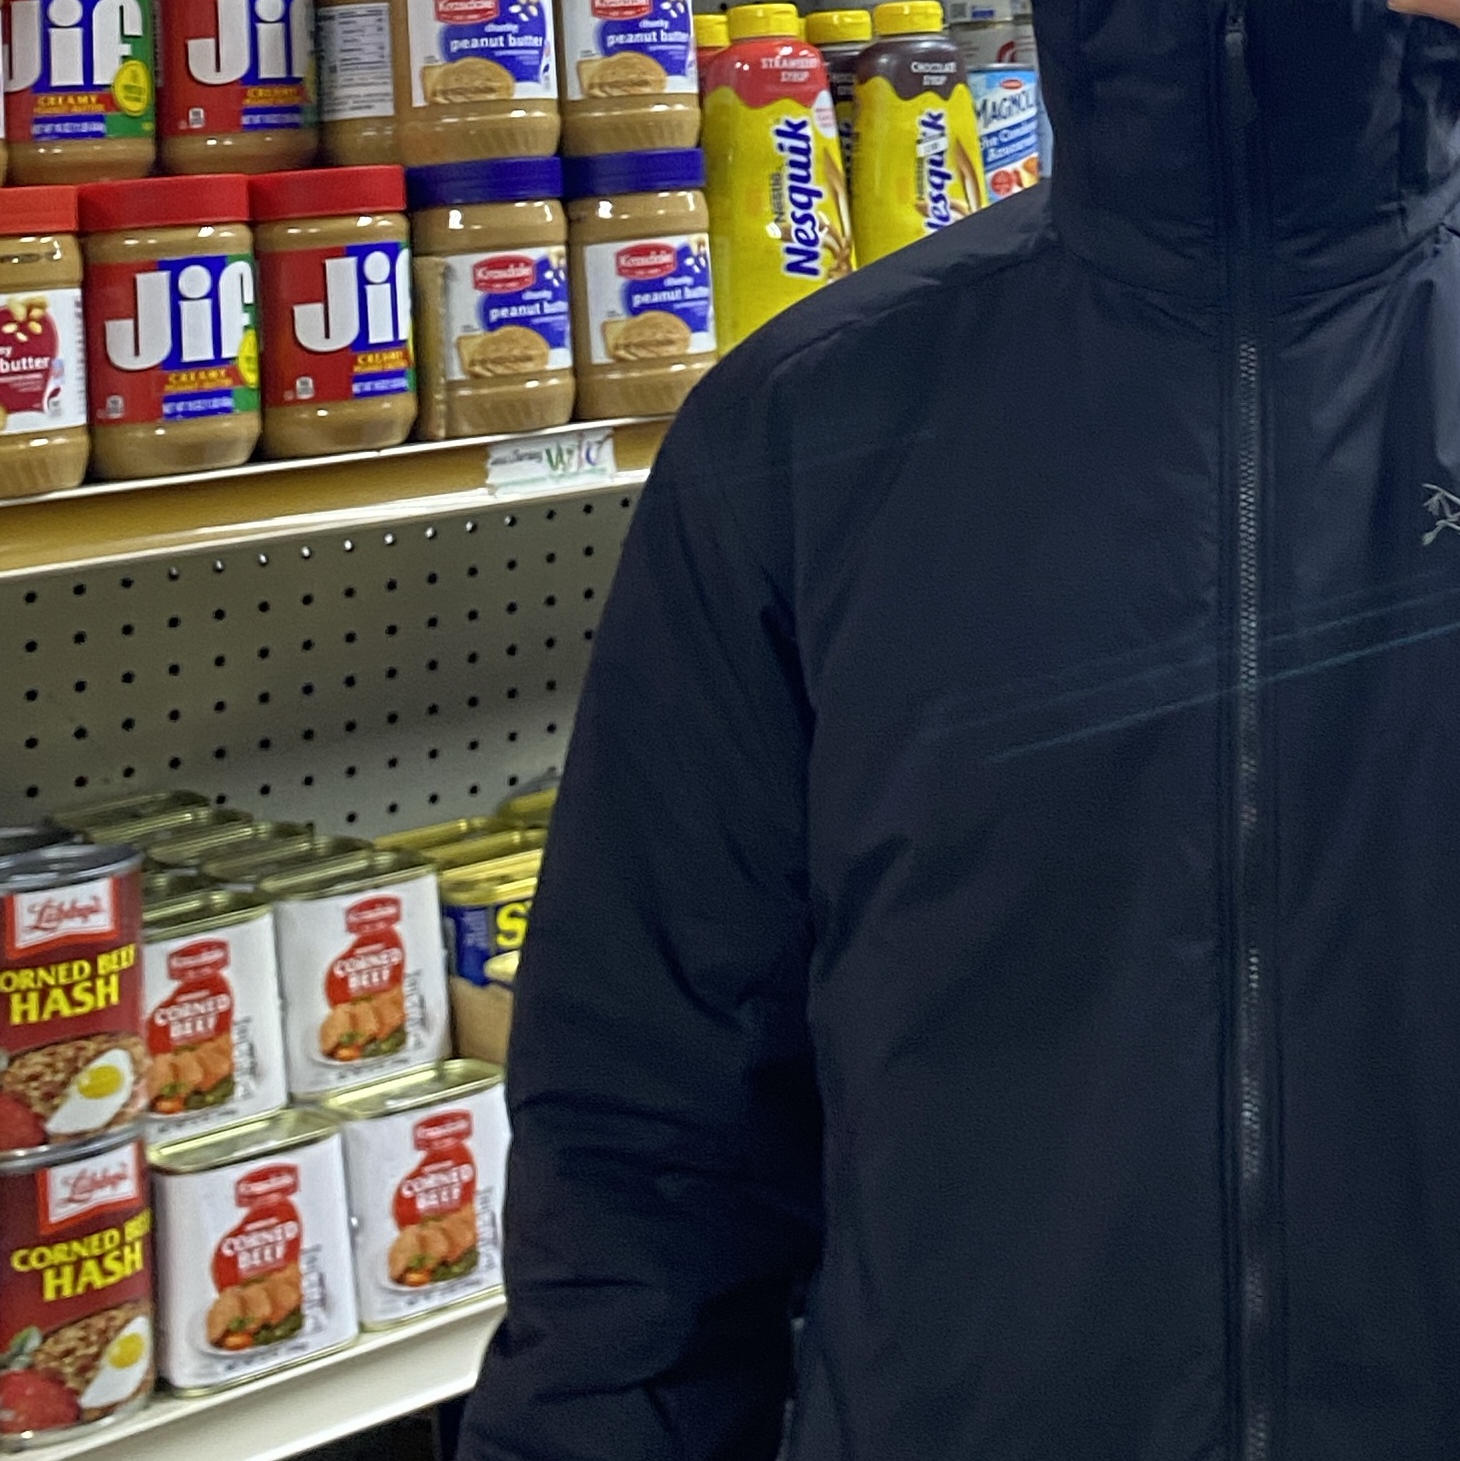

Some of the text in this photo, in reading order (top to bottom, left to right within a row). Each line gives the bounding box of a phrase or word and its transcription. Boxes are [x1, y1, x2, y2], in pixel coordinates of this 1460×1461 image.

[450, 32, 544, 53] peanut butter
[606, 29, 658, 47] peanut
[976, 92, 1036, 129] MAGNOL
[921, 111, 953, 232] esquk
[774, 118, 823, 277] Nesquik
[489, 301, 568, 323] peanut butt
[632, 288, 682, 307] peanut
[105, 261, 254, 371] Jif
[0, 356, 50, 373] butter
[497, 902, 528, 947] S
[0, 959, 91, 993] ORNED
[350, 968, 390, 990] BEEF
[10, 974, 121, 1026] HASH
[402, 1164, 474, 1193] CORNED
[11, 1229, 117, 1273] CORNED
[221, 1221, 299, 1256] CORNED
[43, 1242, 145, 1302] HASH
[237, 1245, 285, 1270] BEEF
